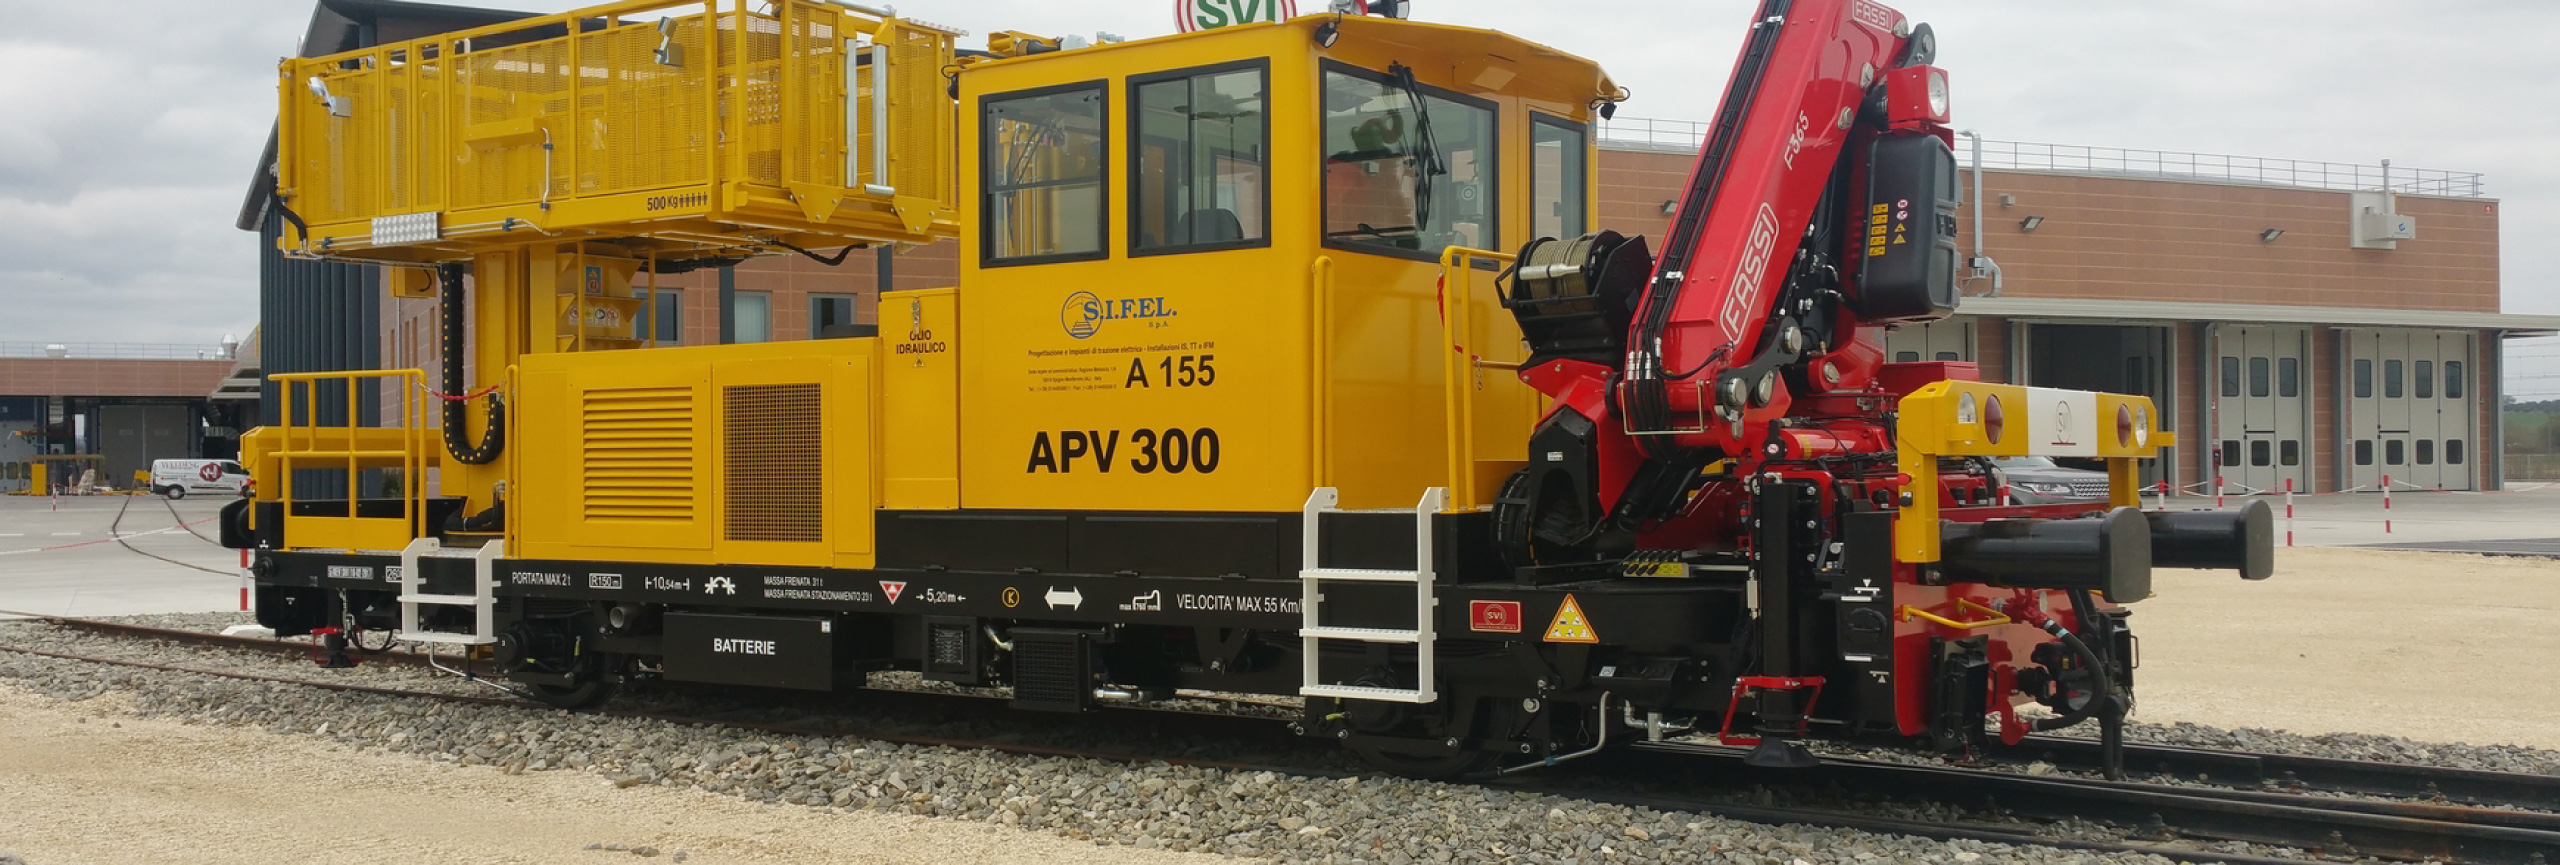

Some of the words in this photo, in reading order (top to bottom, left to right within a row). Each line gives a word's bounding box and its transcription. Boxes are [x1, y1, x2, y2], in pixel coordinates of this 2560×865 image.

[1197, 0, 1275, 29] SVI
[1855, 1, 1889, 28] FASSI
[1784, 110, 1809, 170] F365
[647, 196, 666, 211] 500
[1725, 213, 1774, 334] FASSI
[910, 330, 931, 341] OLIO
[896, 342, 946, 355] IDRAULICO
[1121, 344, 1142, 352] elettrica
[1147, 342, 1180, 352] Installazioni
[1190, 342, 1197, 350] TT
[1203, 341, 1215, 349] IFM
[1125, 357, 1149, 389] A
[1160, 354, 1215, 388] 155
[1026, 430, 1120, 474] APV
[1130, 427, 1220, 475] 300
[512, 572, 543, 585] PORTATA
[544, 573, 560, 586] MAX
[562, 573, 566, 586] 2
[591, 575, 611, 587] R150
[764, 576, 784, 586] MASSA
[785, 577, 811, 587] FRENATA
[764, 589, 784, 599] MASSA
[785, 589, 811, 600] FRENATA
[812, 590, 860, 601] STAZIONAMENTO
[1176, 594, 1235, 611] VELOCITA'
[1236, 596, 1262, 612] MAX
[1264, 597, 1277, 613] 55
[1280, 598, 1304, 614] Km/
[1487, 611, 1503, 620] SVI
[713, 638, 776, 656] BATTERIE
